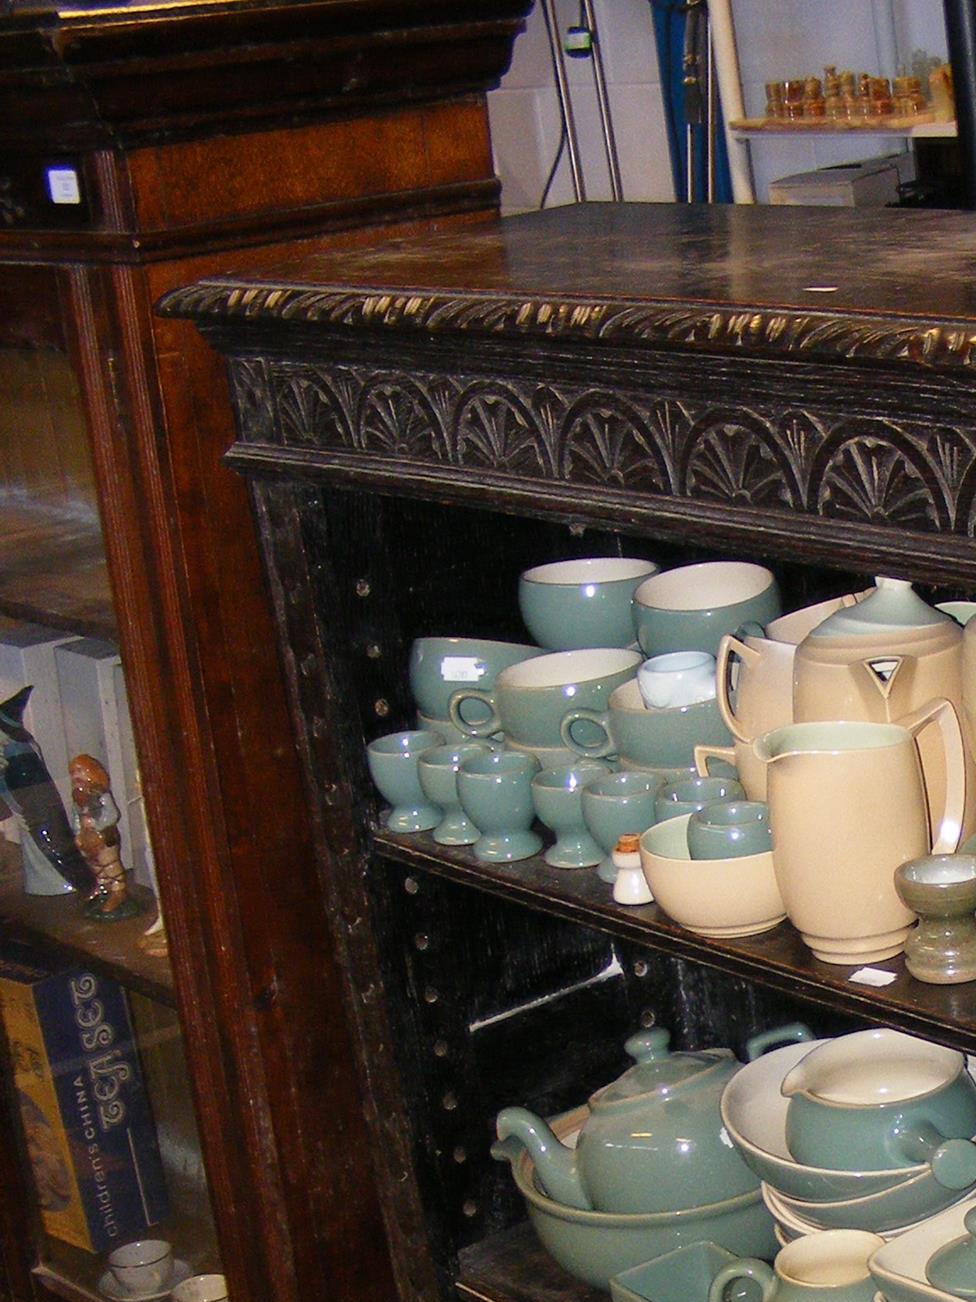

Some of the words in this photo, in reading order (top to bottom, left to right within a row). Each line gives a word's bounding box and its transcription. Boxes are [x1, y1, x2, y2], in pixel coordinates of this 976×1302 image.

[70, 974, 113, 1051] SET
[73, 1075, 97, 1140] CHINA
[88, 1048, 130, 1131] TEA
[88, 1142, 119, 1239] children's
